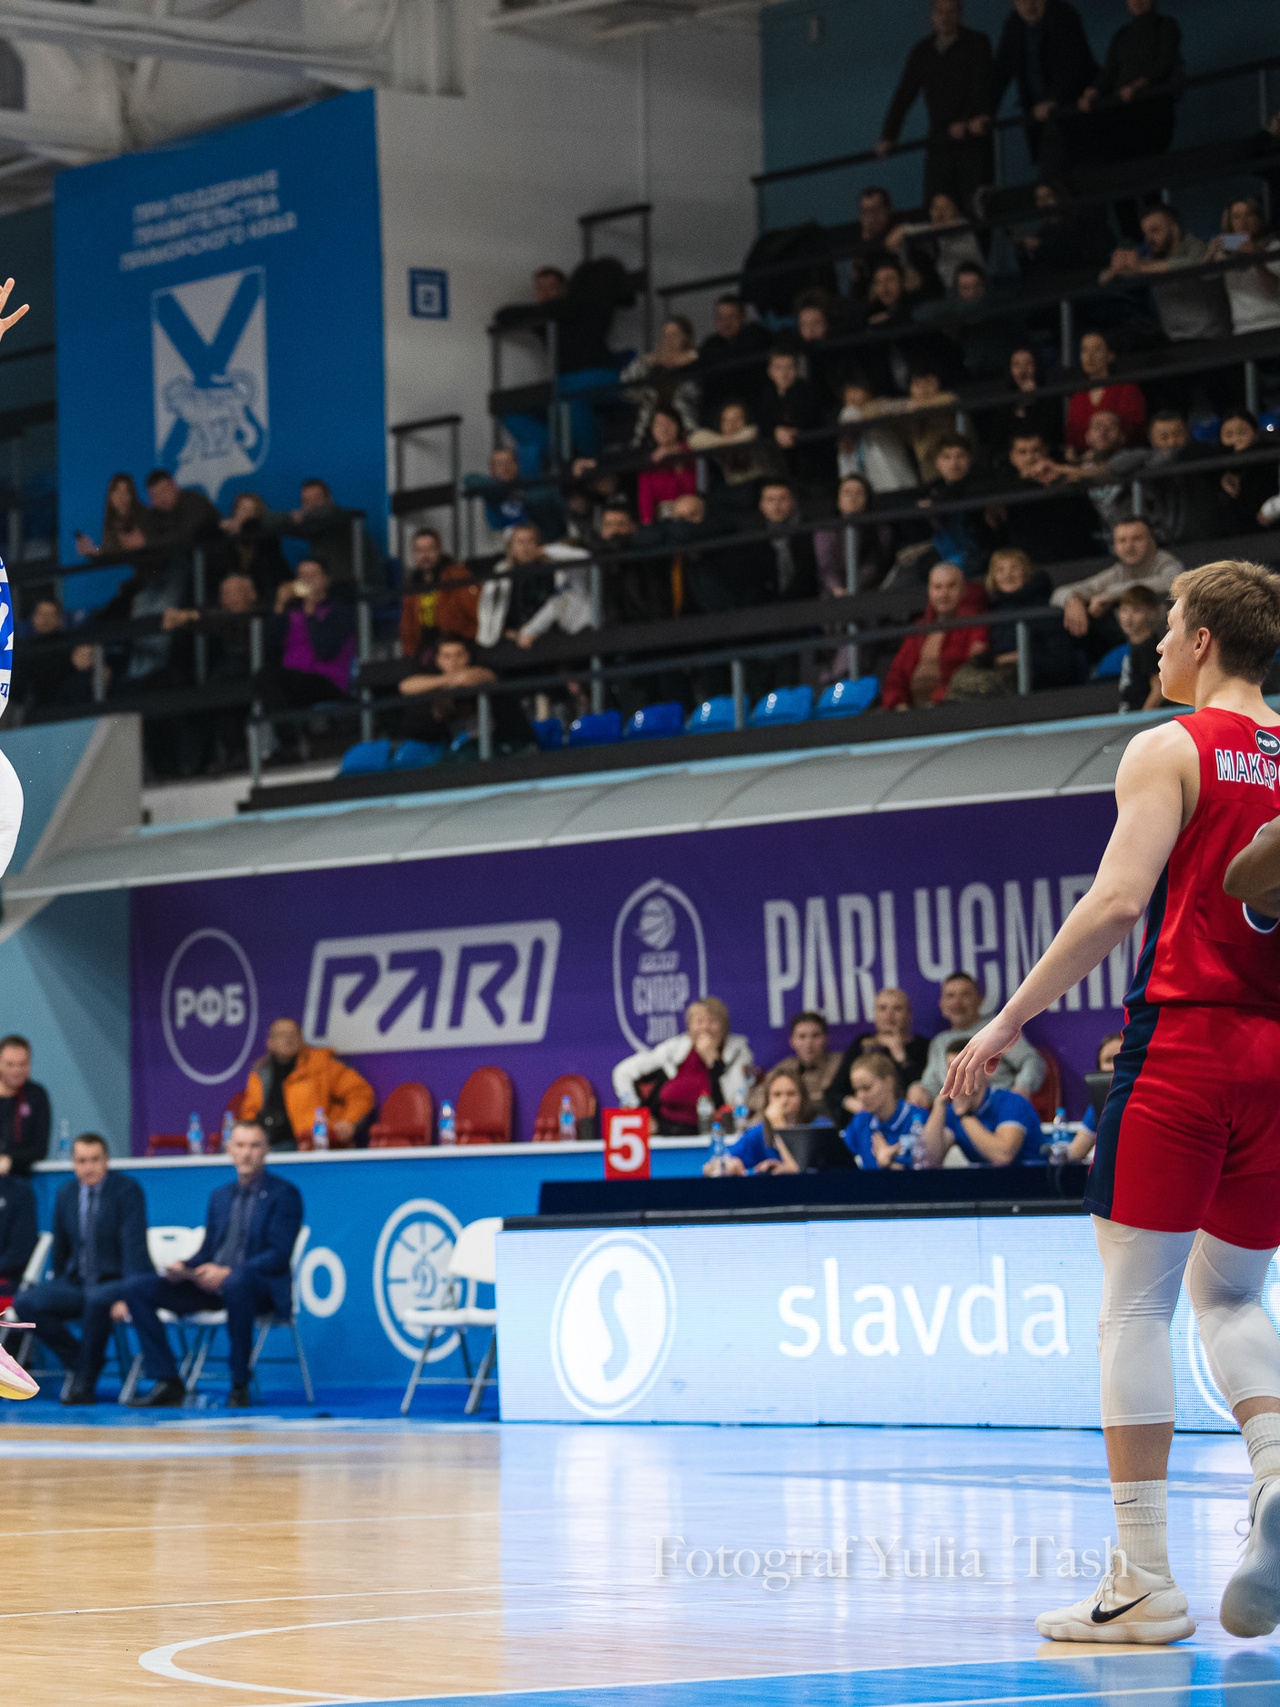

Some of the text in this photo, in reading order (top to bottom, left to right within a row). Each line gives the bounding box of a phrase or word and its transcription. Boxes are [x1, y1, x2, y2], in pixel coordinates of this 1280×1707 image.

[1215, 748, 1280, 792] МАКАР
[313, 936, 547, 1039] PARI
[764, 891, 898, 1028] PARI
[175, 983, 246, 1030] РФБ
[607, 1115, 646, 1172] 5
[778, 1255, 1071, 1358] slavda
